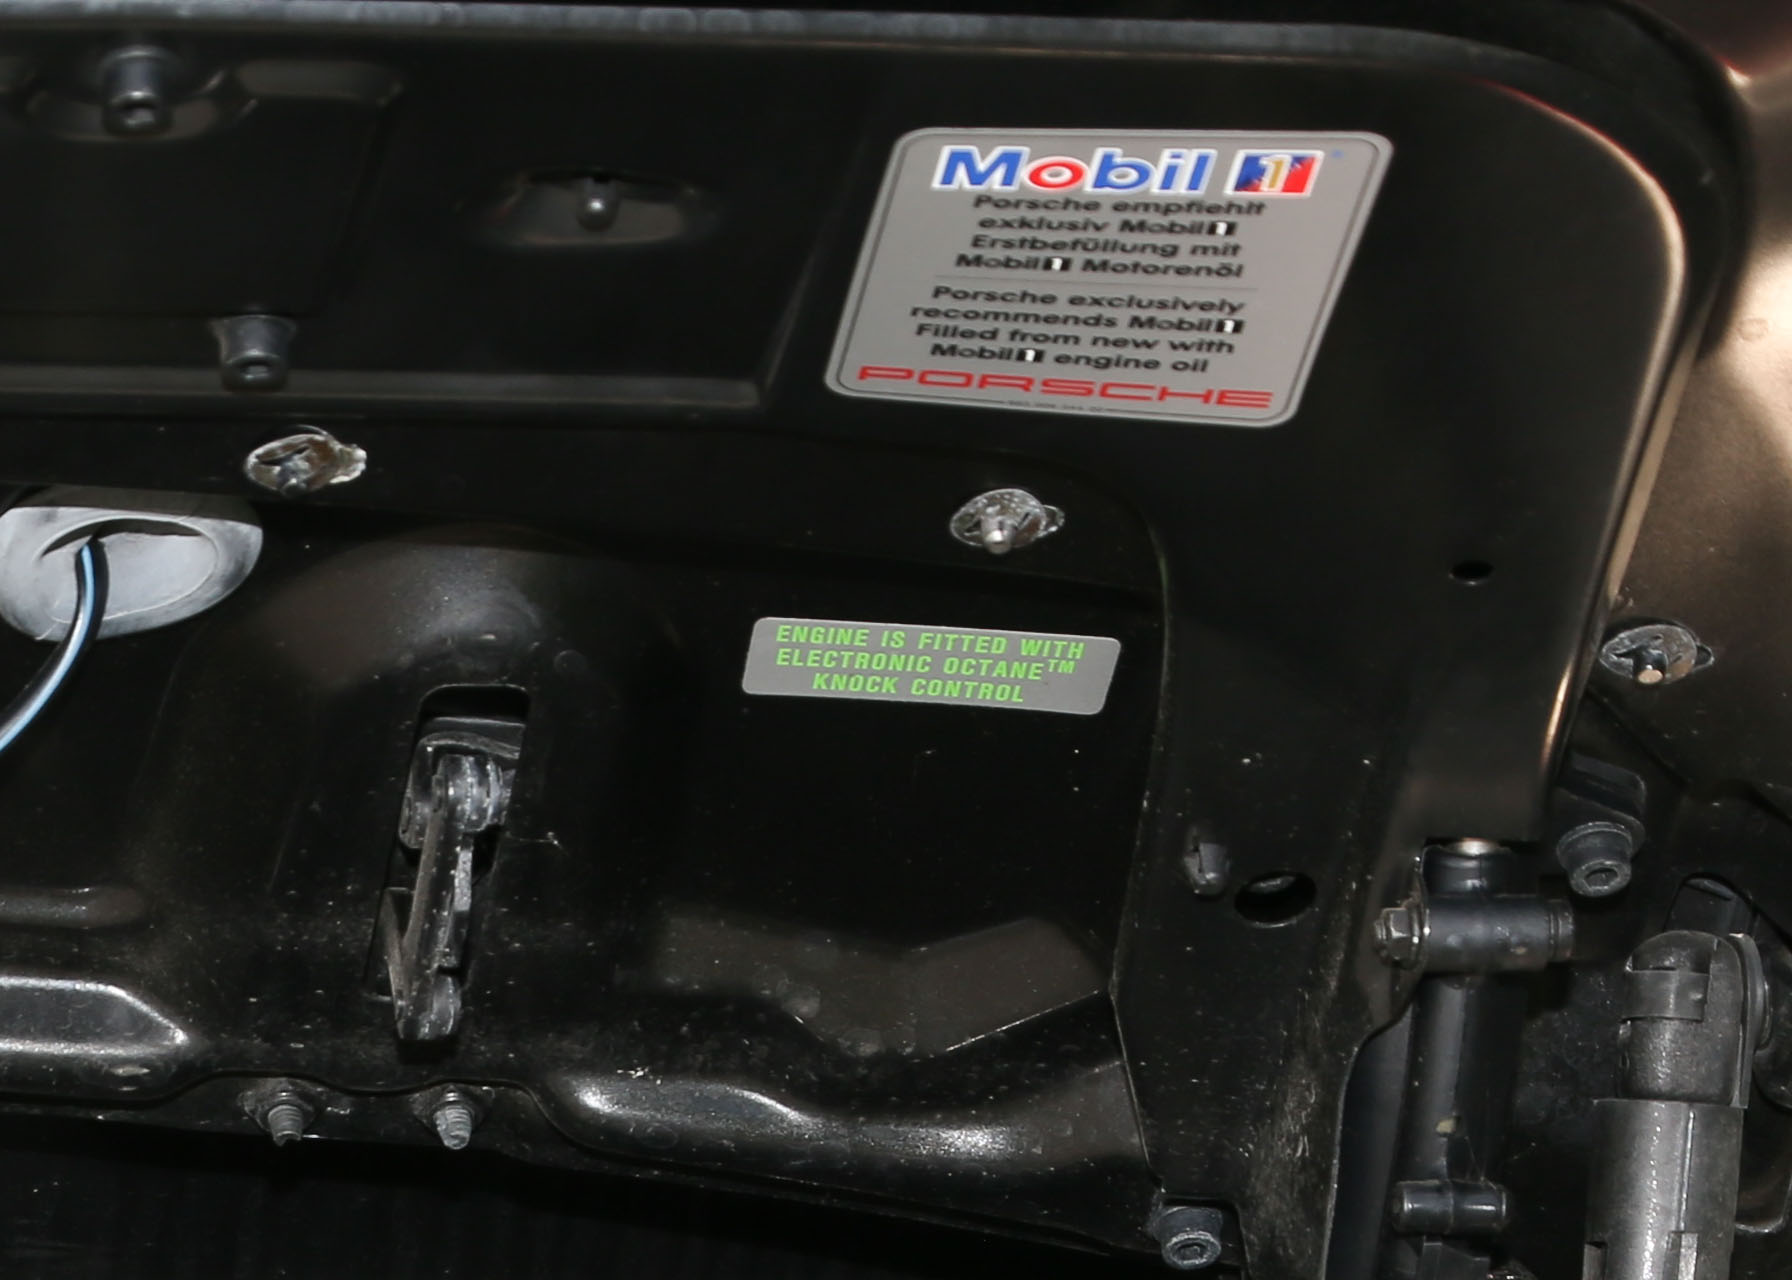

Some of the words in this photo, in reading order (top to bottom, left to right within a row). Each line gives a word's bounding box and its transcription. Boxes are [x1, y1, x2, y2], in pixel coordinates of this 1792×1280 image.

[931, 145, 1217, 194] Mobil
[972, 194, 1102, 212] Porsche
[1112, 198, 1267, 218] empfiehlt
[978, 216, 1110, 234] exklusiv
[970, 234, 1180, 258] Erstbefüllung
[1190, 241, 1243, 258] mit
[1080, 257, 1245, 278] Motorenöl
[931, 285, 1059, 306] Porsche
[1068, 292, 1247, 316] exclusively
[909, 306, 1118, 328] recommends
[915, 323, 999, 342] Filled
[1008, 327, 1081, 346] from
[1091, 335, 1159, 351] new
[1167, 335, 1236, 355] with
[1053, 350, 1162, 373] engine
[1170, 356, 1208, 373] oil
[857, 365, 1274, 409] PORSCHE
[776, 624, 870, 647] ENGINE
[881, 630, 906, 648] IS
[918, 632, 1009, 655] FITTED
[1020, 638, 1086, 660] WITH
[776, 648, 932, 674] ELECTRONIC
[812, 673, 898, 694] KNOCK
[911, 678, 1025, 703] CONTROL
